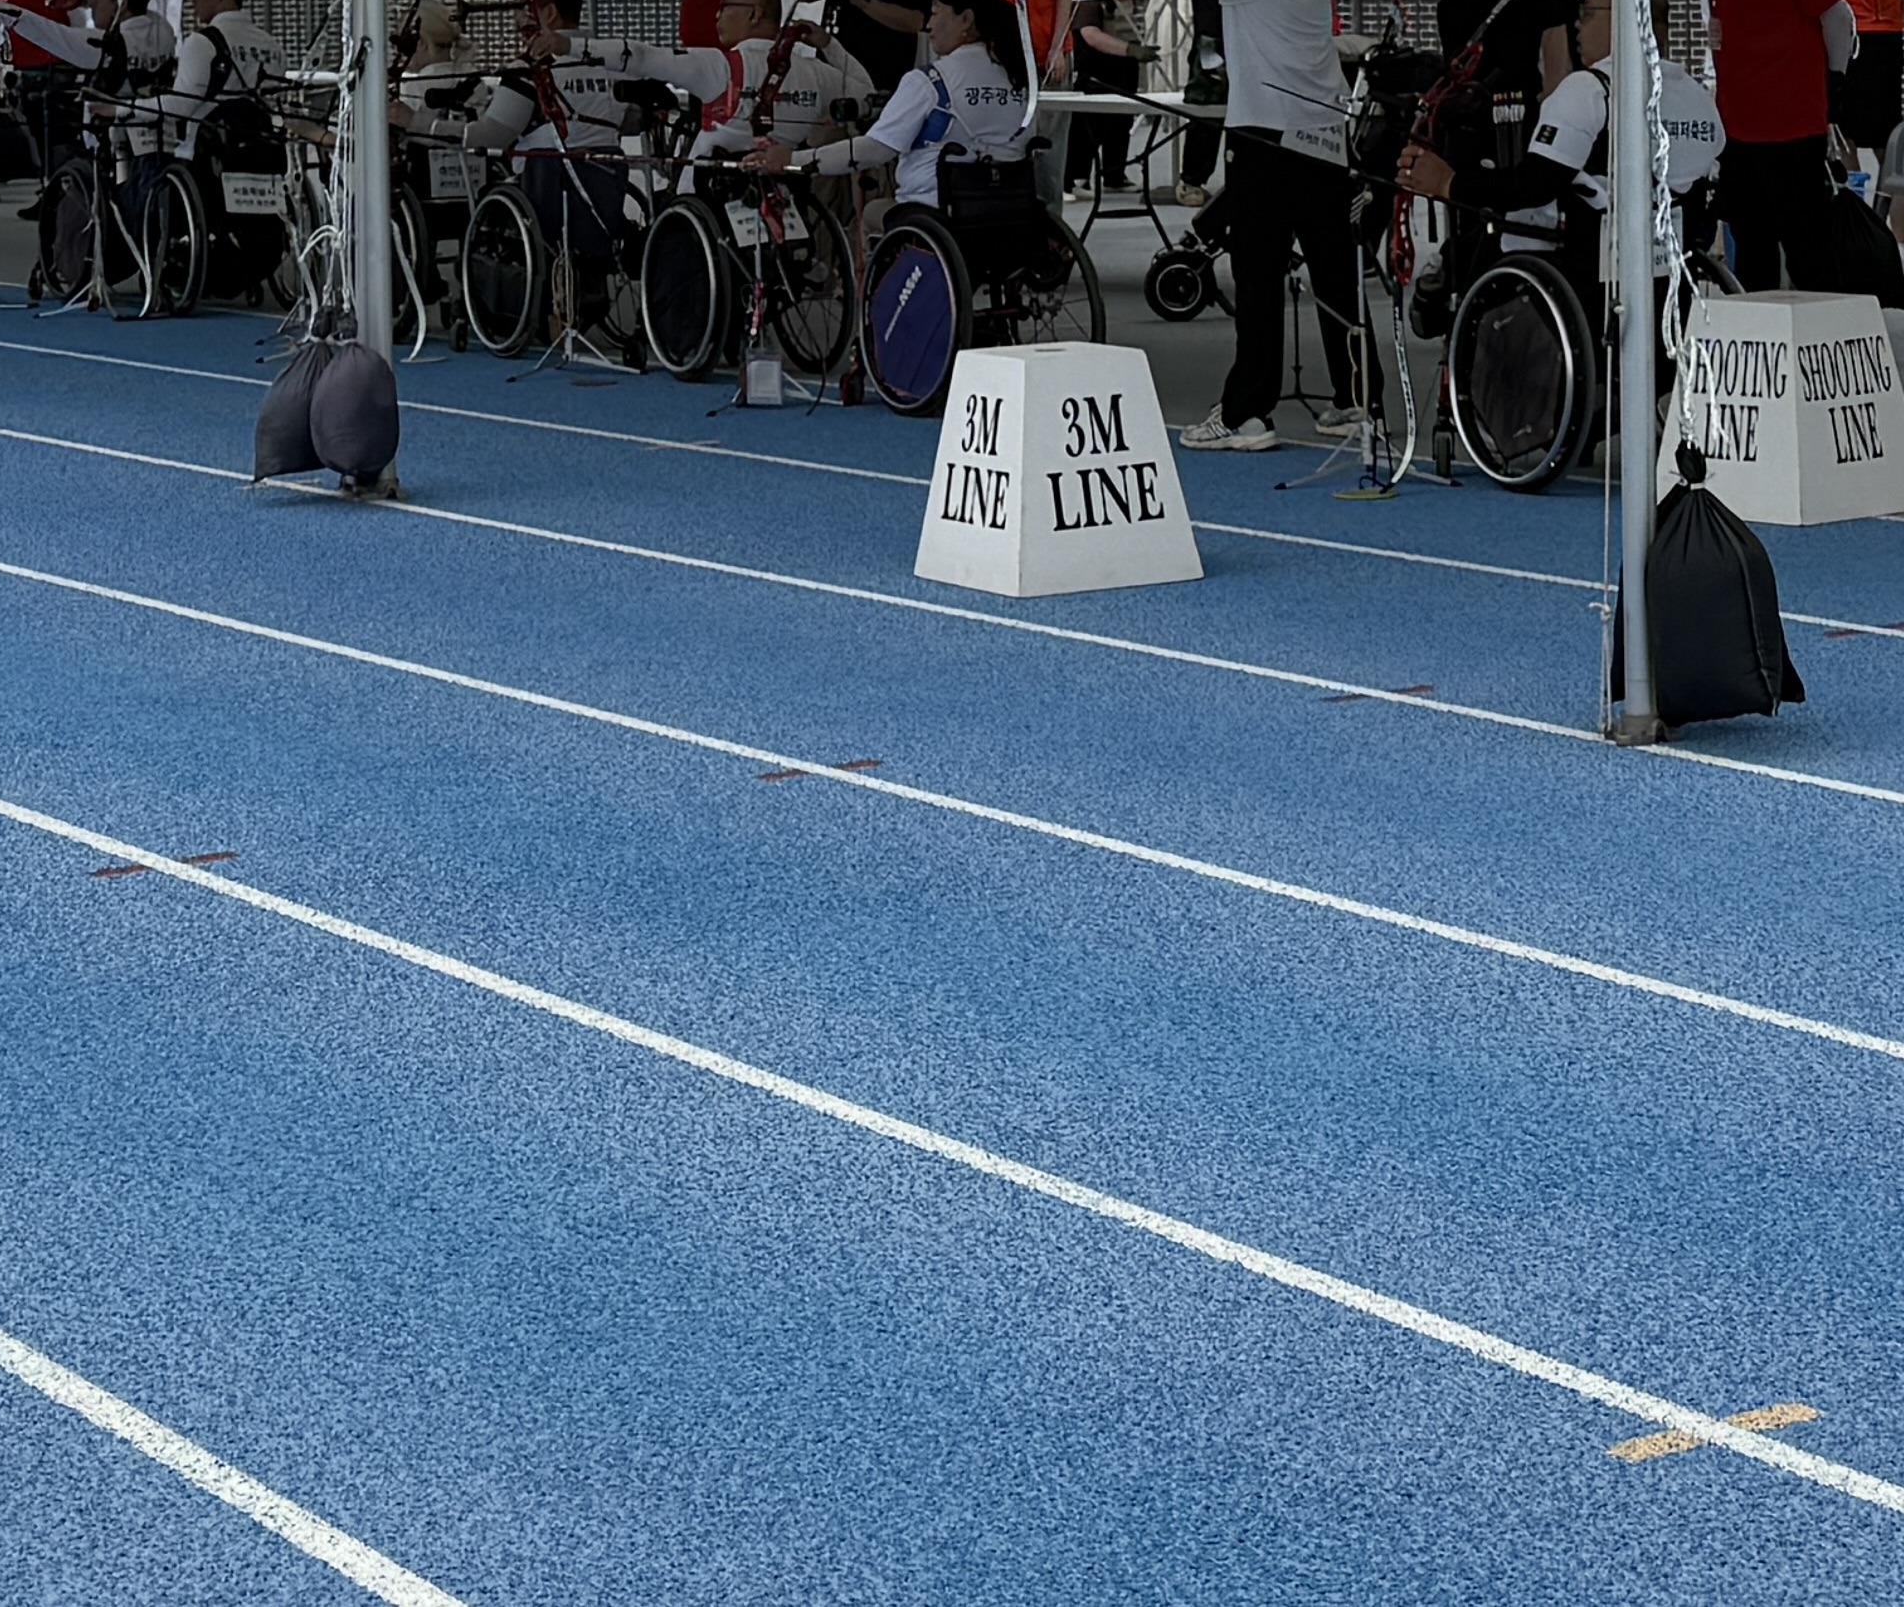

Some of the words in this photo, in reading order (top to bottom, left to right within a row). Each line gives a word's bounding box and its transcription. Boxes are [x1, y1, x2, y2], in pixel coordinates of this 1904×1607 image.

[965, 87, 1024, 105] 광주광역
[1692, 338, 1788, 399] HOOTING
[1797, 335, 1892, 402] SHOOTING
[961, 394, 1003, 456] 3M
[1061, 394, 1130, 458] 3M
[1704, 402, 1759, 462] LINE
[1828, 402, 1884, 464] LINE
[941, 462, 1010, 530] LINE
[1046, 461, 1165, 532] LINE
